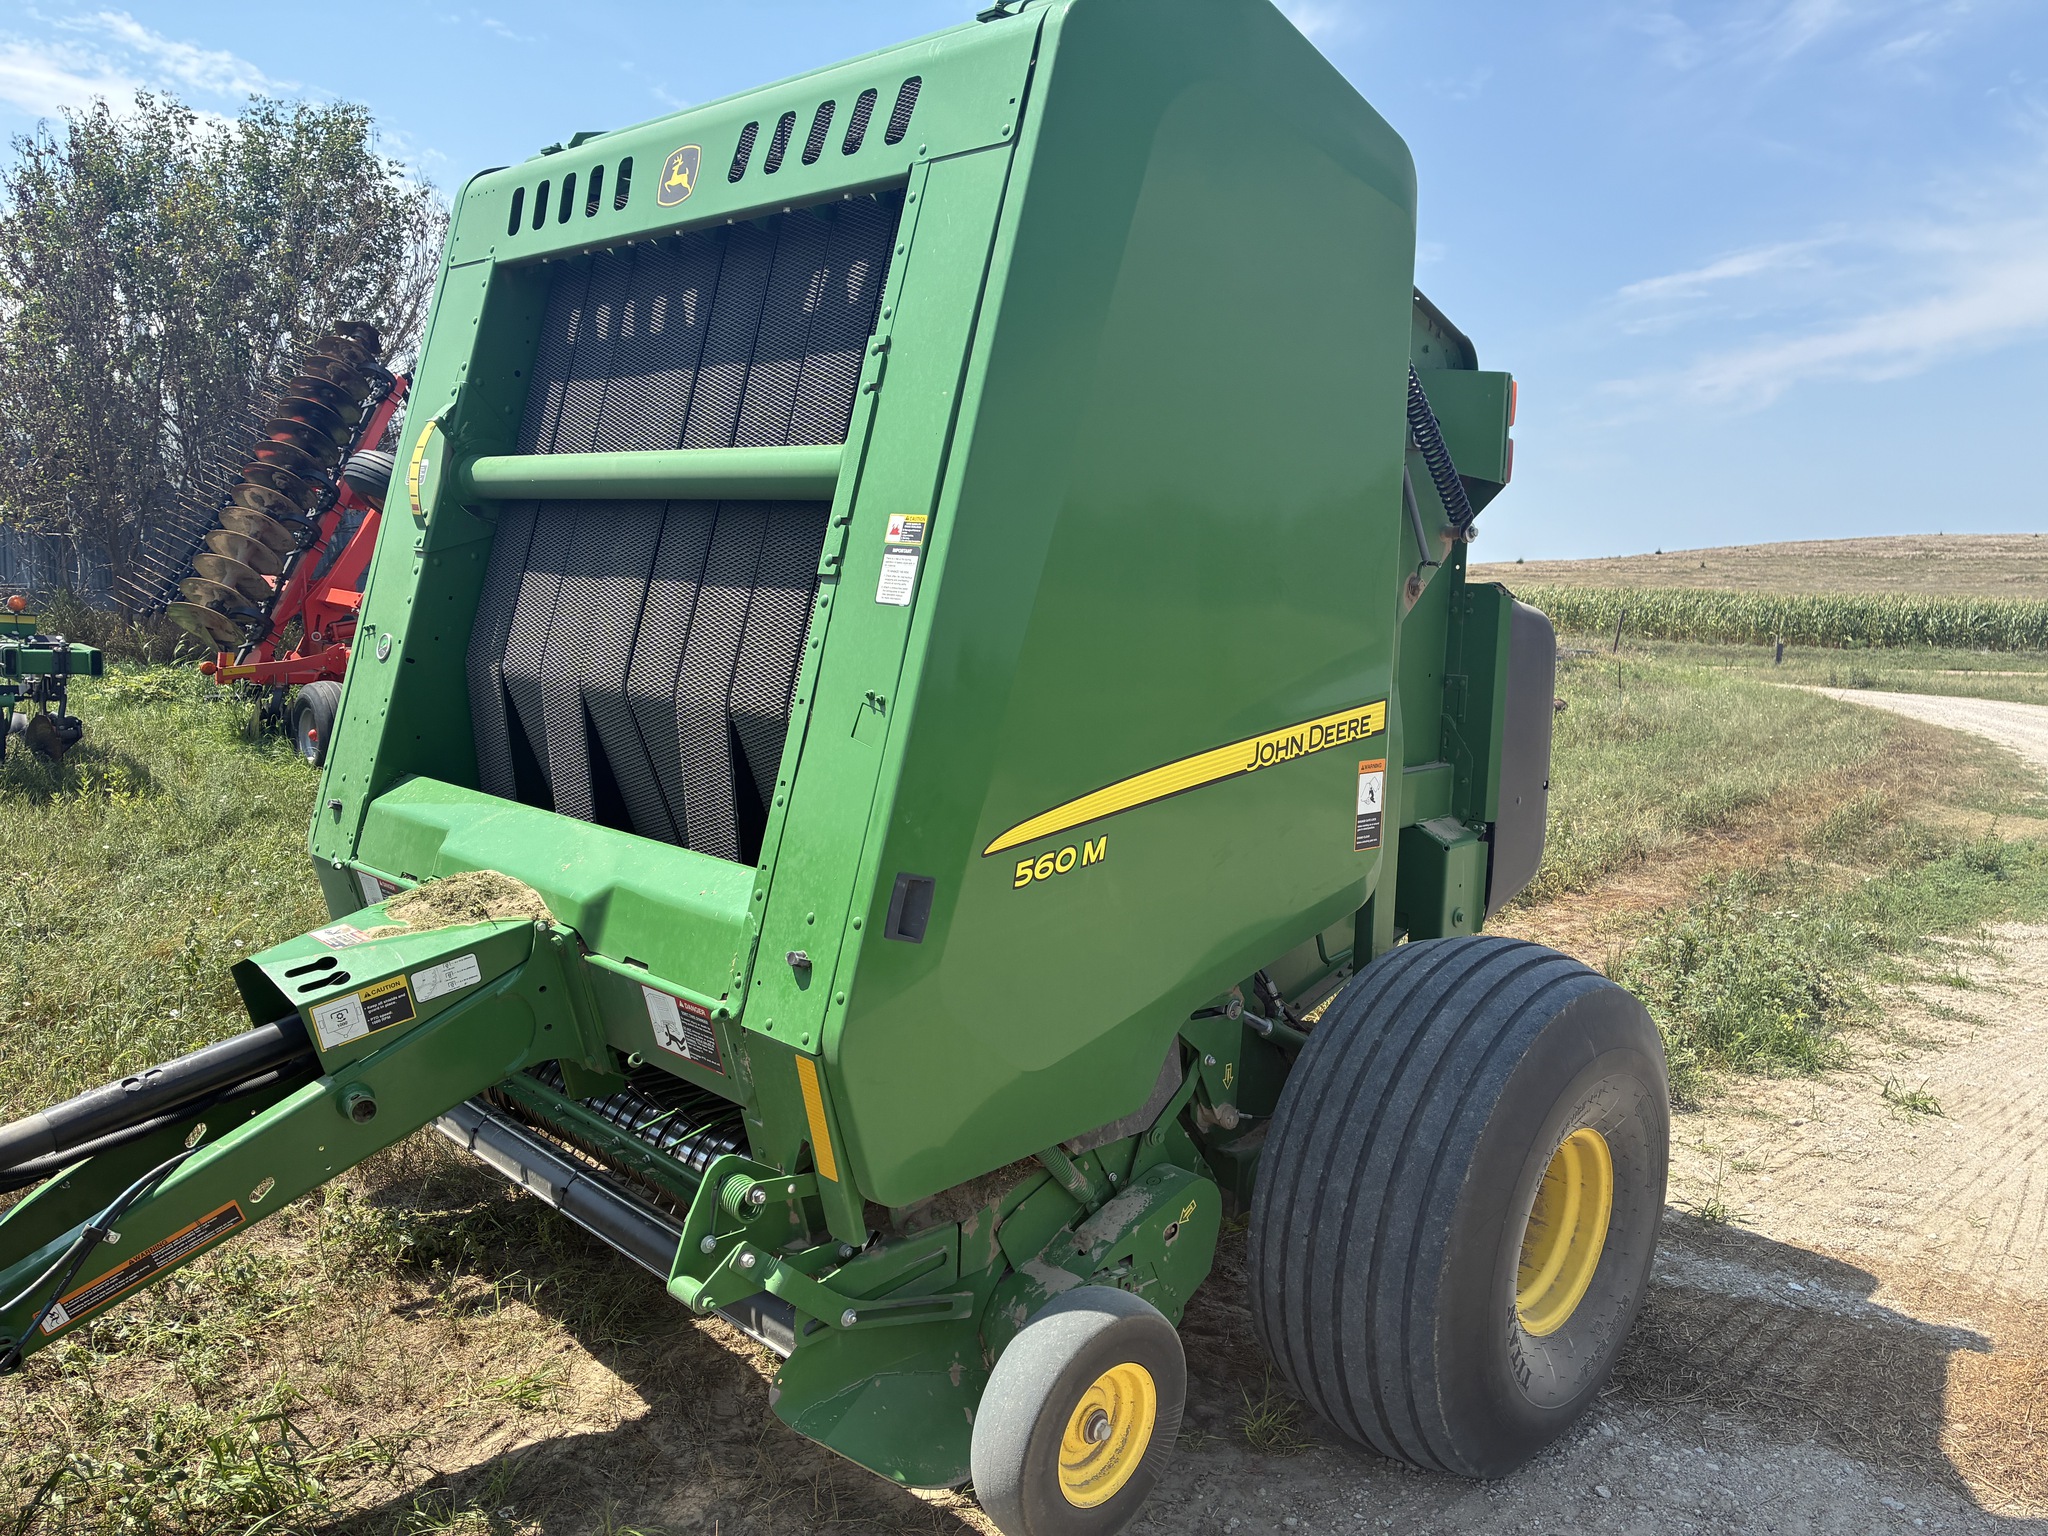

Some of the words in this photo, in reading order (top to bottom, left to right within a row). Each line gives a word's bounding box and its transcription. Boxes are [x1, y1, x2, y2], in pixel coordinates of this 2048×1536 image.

[1247, 732, 1304, 769] JOHN
[1308, 714, 1372, 750] DEERE
[1012, 845, 1078, 890] 560
[1080, 833, 1108, 868] M
[371, 980, 401, 996] CAUTION
[684, 1002, 706, 1016] DANGER
[133, 1240, 168, 1261] WARNING
